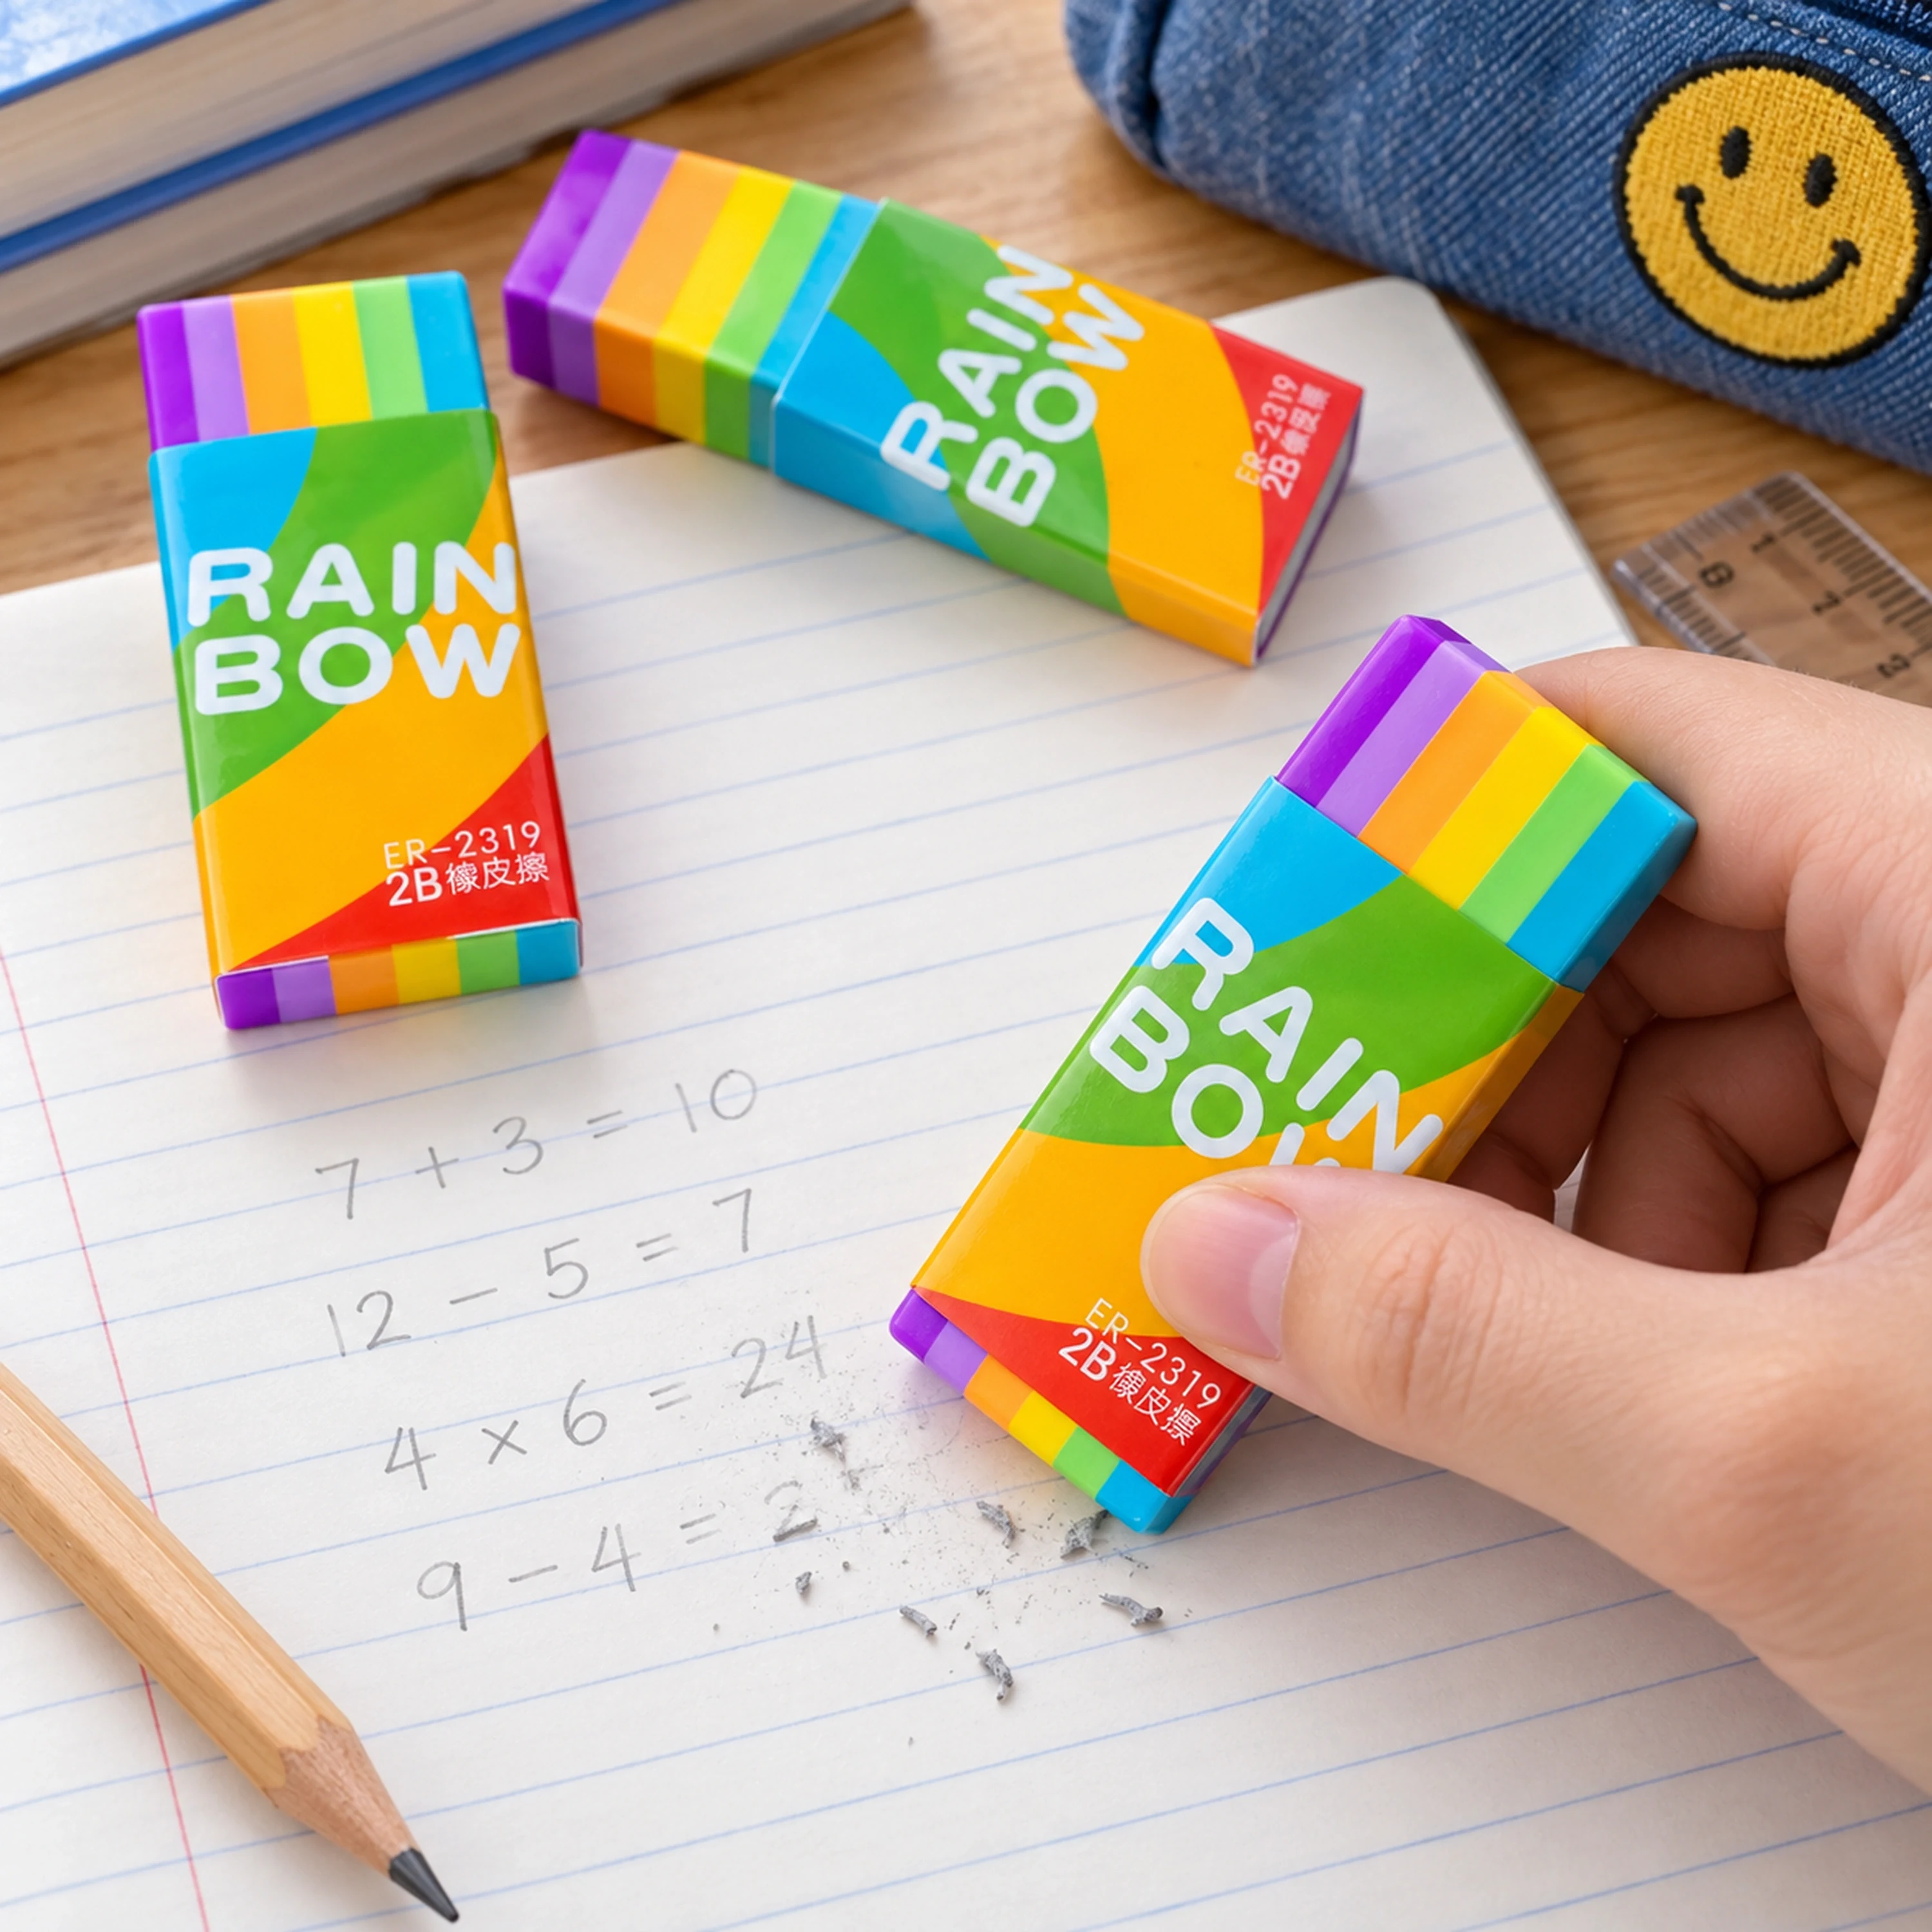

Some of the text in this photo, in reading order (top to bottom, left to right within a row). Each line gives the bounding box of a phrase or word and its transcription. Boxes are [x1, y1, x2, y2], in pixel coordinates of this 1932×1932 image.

[880, 245, 1074, 491] RAIN
[966, 283, 1145, 527] BOW
[1235, 374, 1299, 488] ER-2319
[188, 542, 516, 627] RAIN
[194, 623, 520, 715] BOW
[384, 820, 541, 869] ER-2319
[1151, 897, 1443, 1174] RAIN
[314, 1157, 359, 1220] 7
[493, 1117, 544, 1175] 3
[675, 1068, 758, 1133] 10
[327, 1290, 412, 1358] 12
[544, 1238, 589, 1300] 5
[712, 1188, 752, 1253] 7
[384, 1426, 437, 1491] 4
[563, 1378, 607, 1446] 6
[731, 1314, 828, 1399] 24
[1085, 1298, 1222, 1409] ER-2319
[417, 1561, 469, 1632] 9
[591, 1522, 642, 1593] 4
